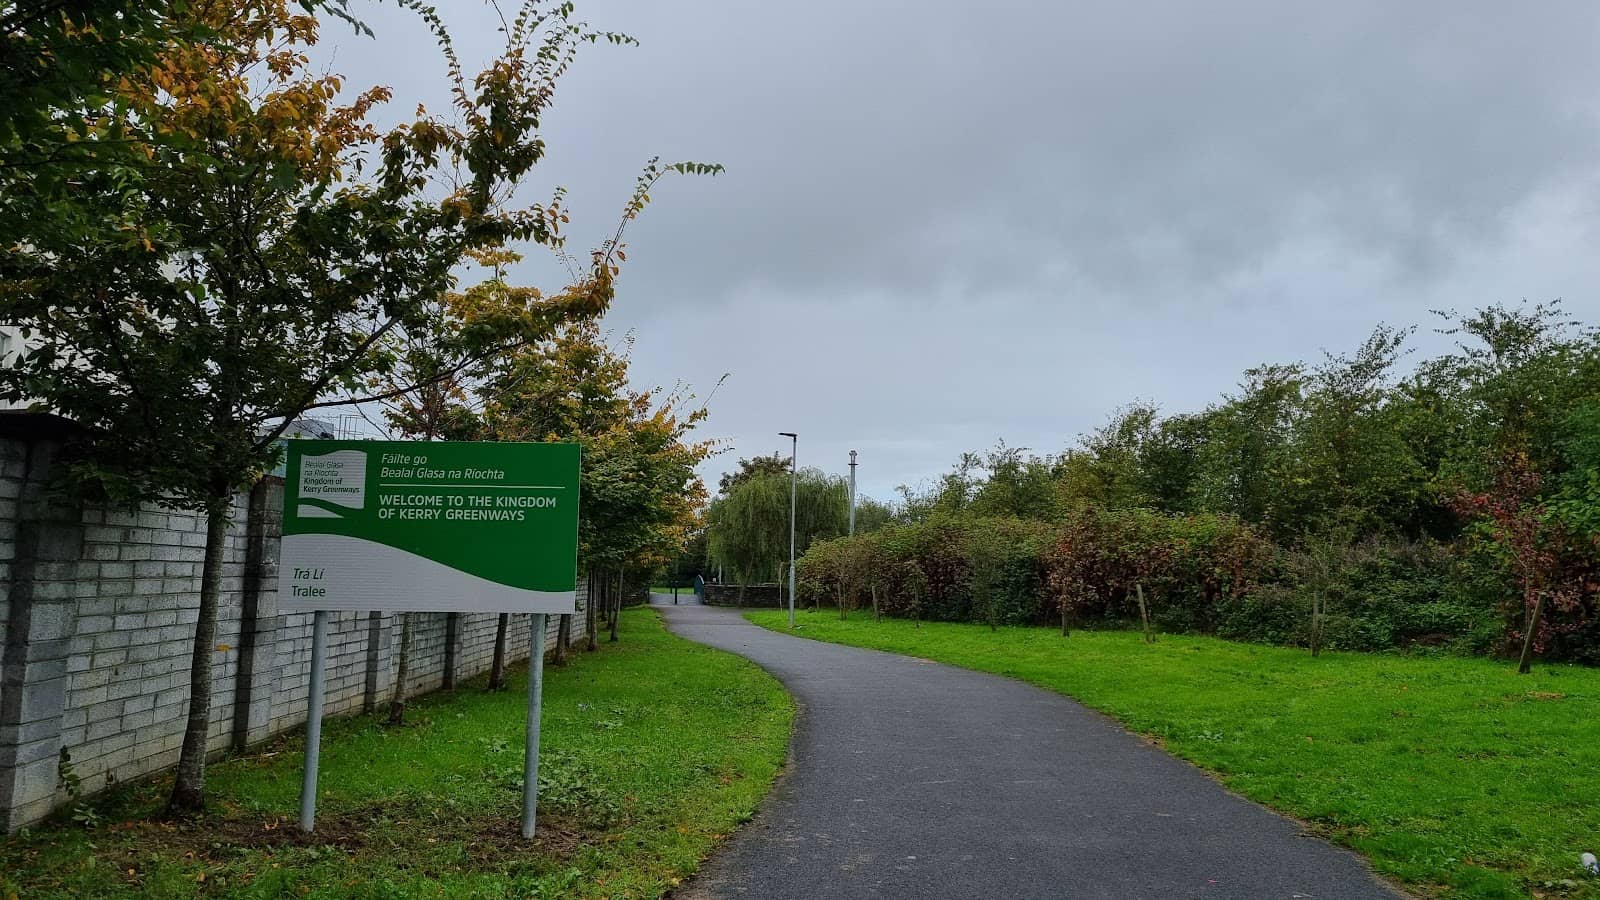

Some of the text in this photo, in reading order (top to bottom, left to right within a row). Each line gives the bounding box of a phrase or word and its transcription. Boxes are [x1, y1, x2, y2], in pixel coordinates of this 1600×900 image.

[381, 453, 428, 466] Fáilte go
[380, 467, 505, 480] Bealaí Glasa na Ríochta
[379, 495, 556, 508] WELCOME TO THE KINGDOM
[378, 508, 525, 521] OF KERRY GREENWAYS
[293, 568, 325, 580] Trá Lí
[291, 585, 326, 597] Tralee
